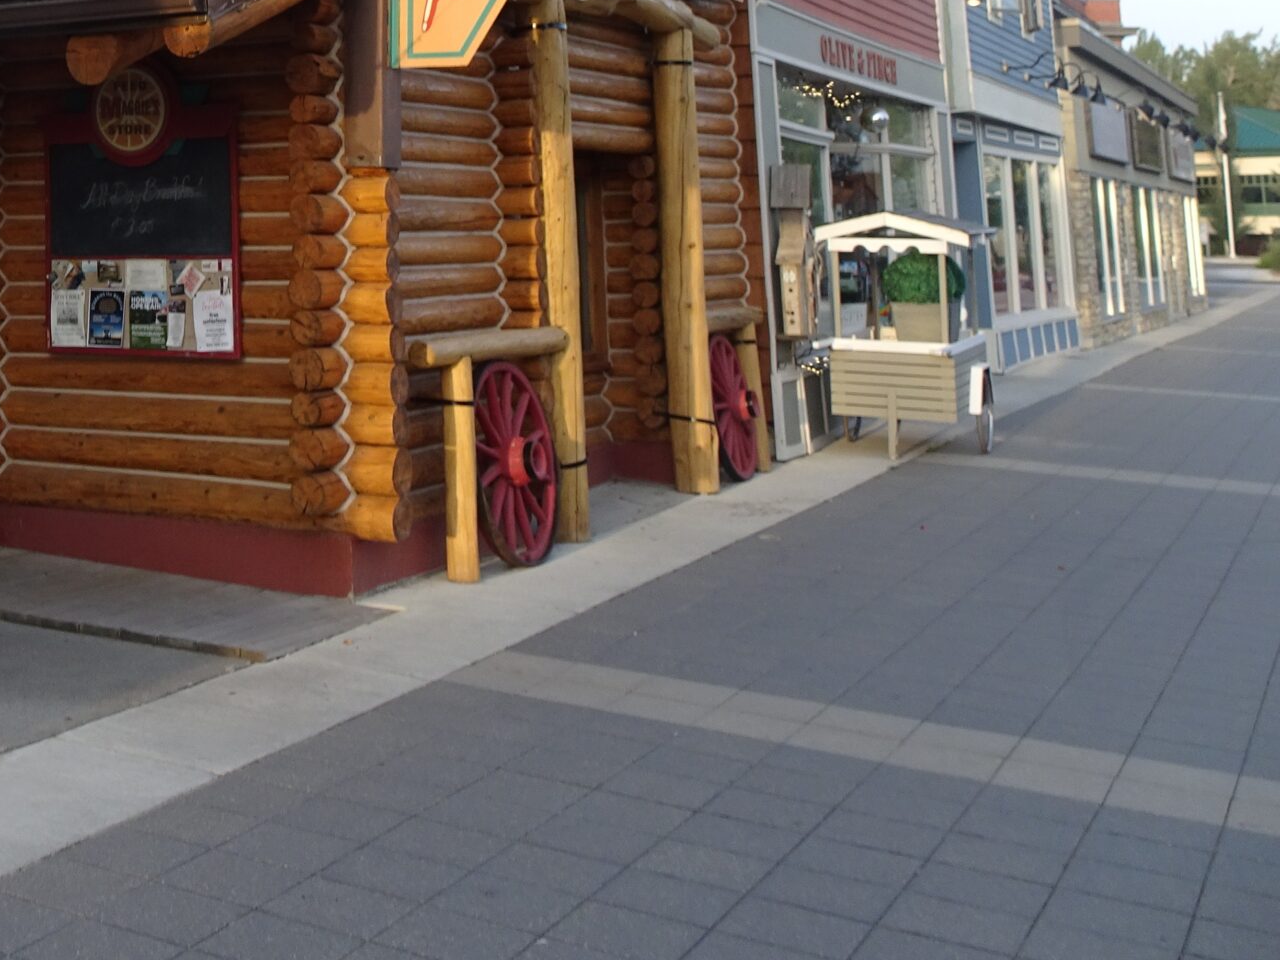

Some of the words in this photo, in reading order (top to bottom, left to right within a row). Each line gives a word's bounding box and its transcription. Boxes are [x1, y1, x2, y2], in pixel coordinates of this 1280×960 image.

[820, 35, 855, 73] OLIVE
[857, 47, 865, 76] &
[866, 50, 897, 86] FINCH
[108, 123, 152, 136] STORE
